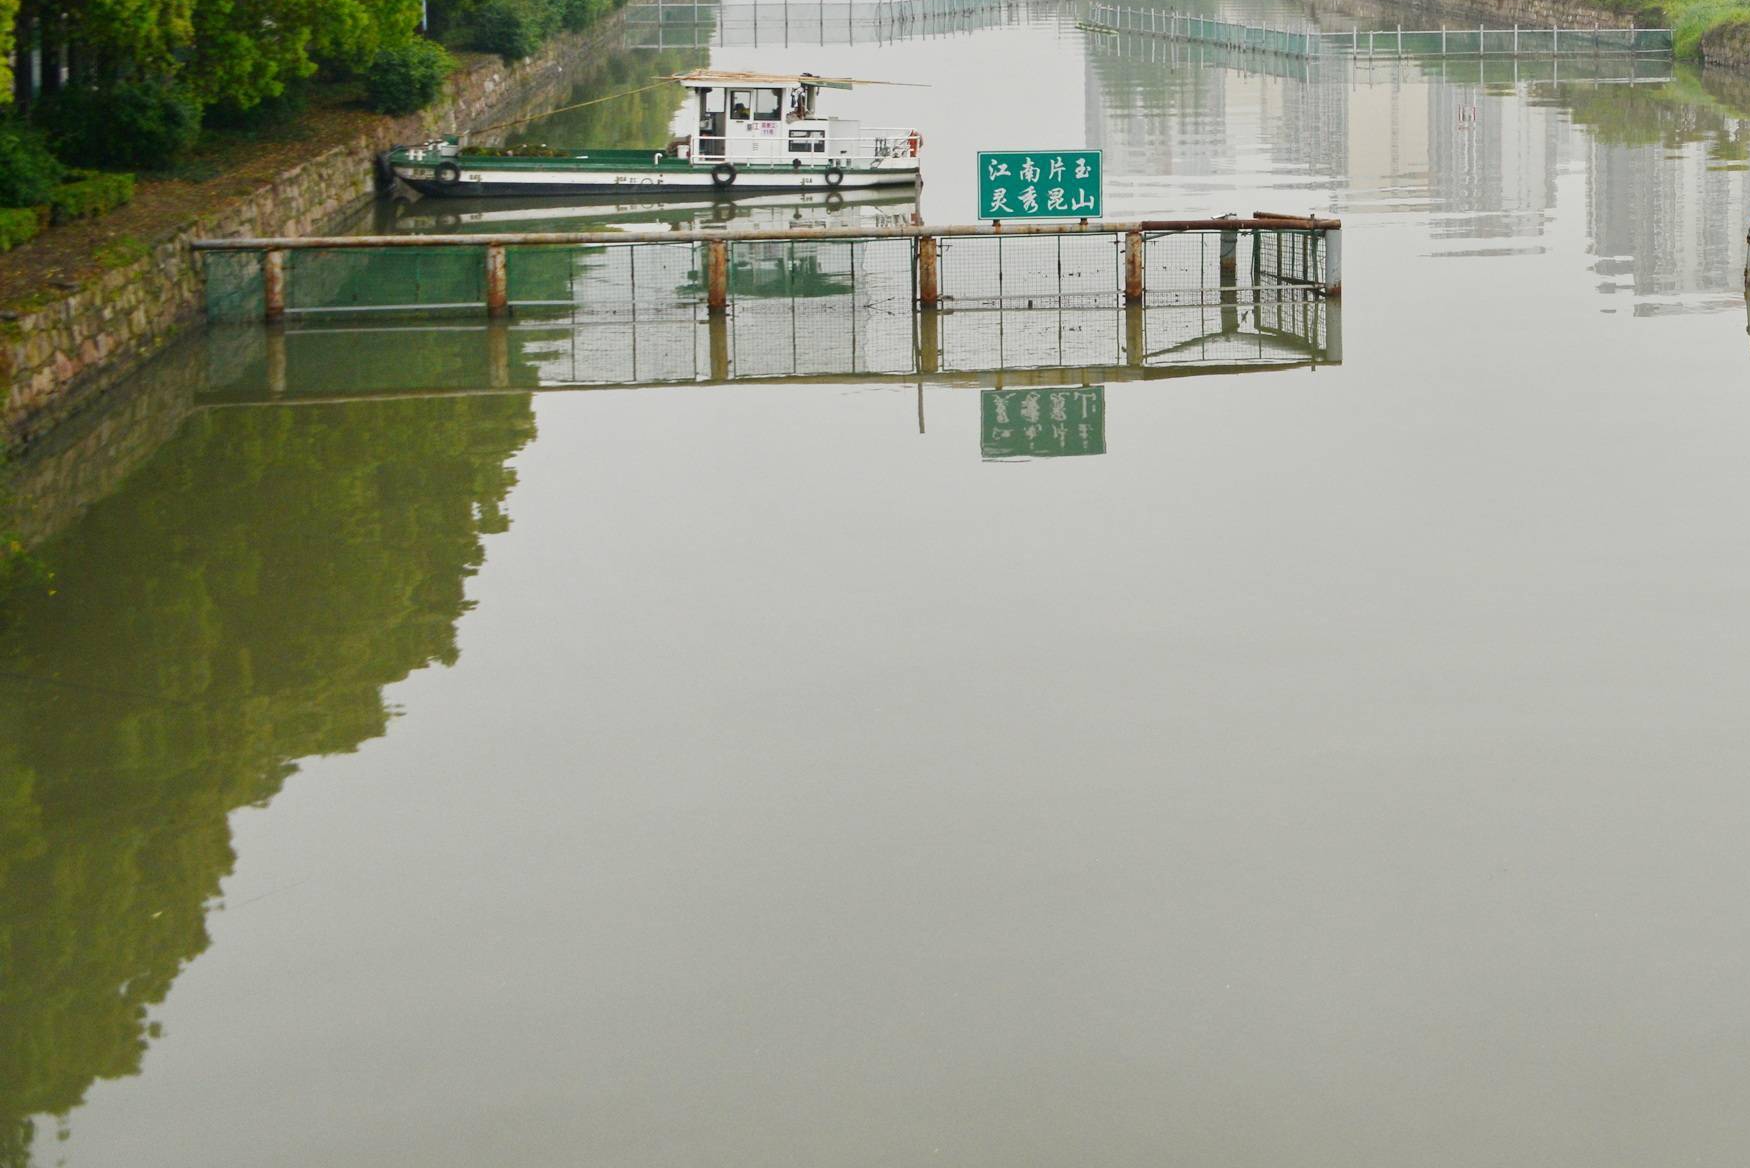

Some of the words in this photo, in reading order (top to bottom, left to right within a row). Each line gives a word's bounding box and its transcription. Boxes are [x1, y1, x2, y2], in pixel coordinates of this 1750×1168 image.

[988, 156, 1092, 182] 江南片玉
[988, 186, 1095, 213] 灵秀昆山
